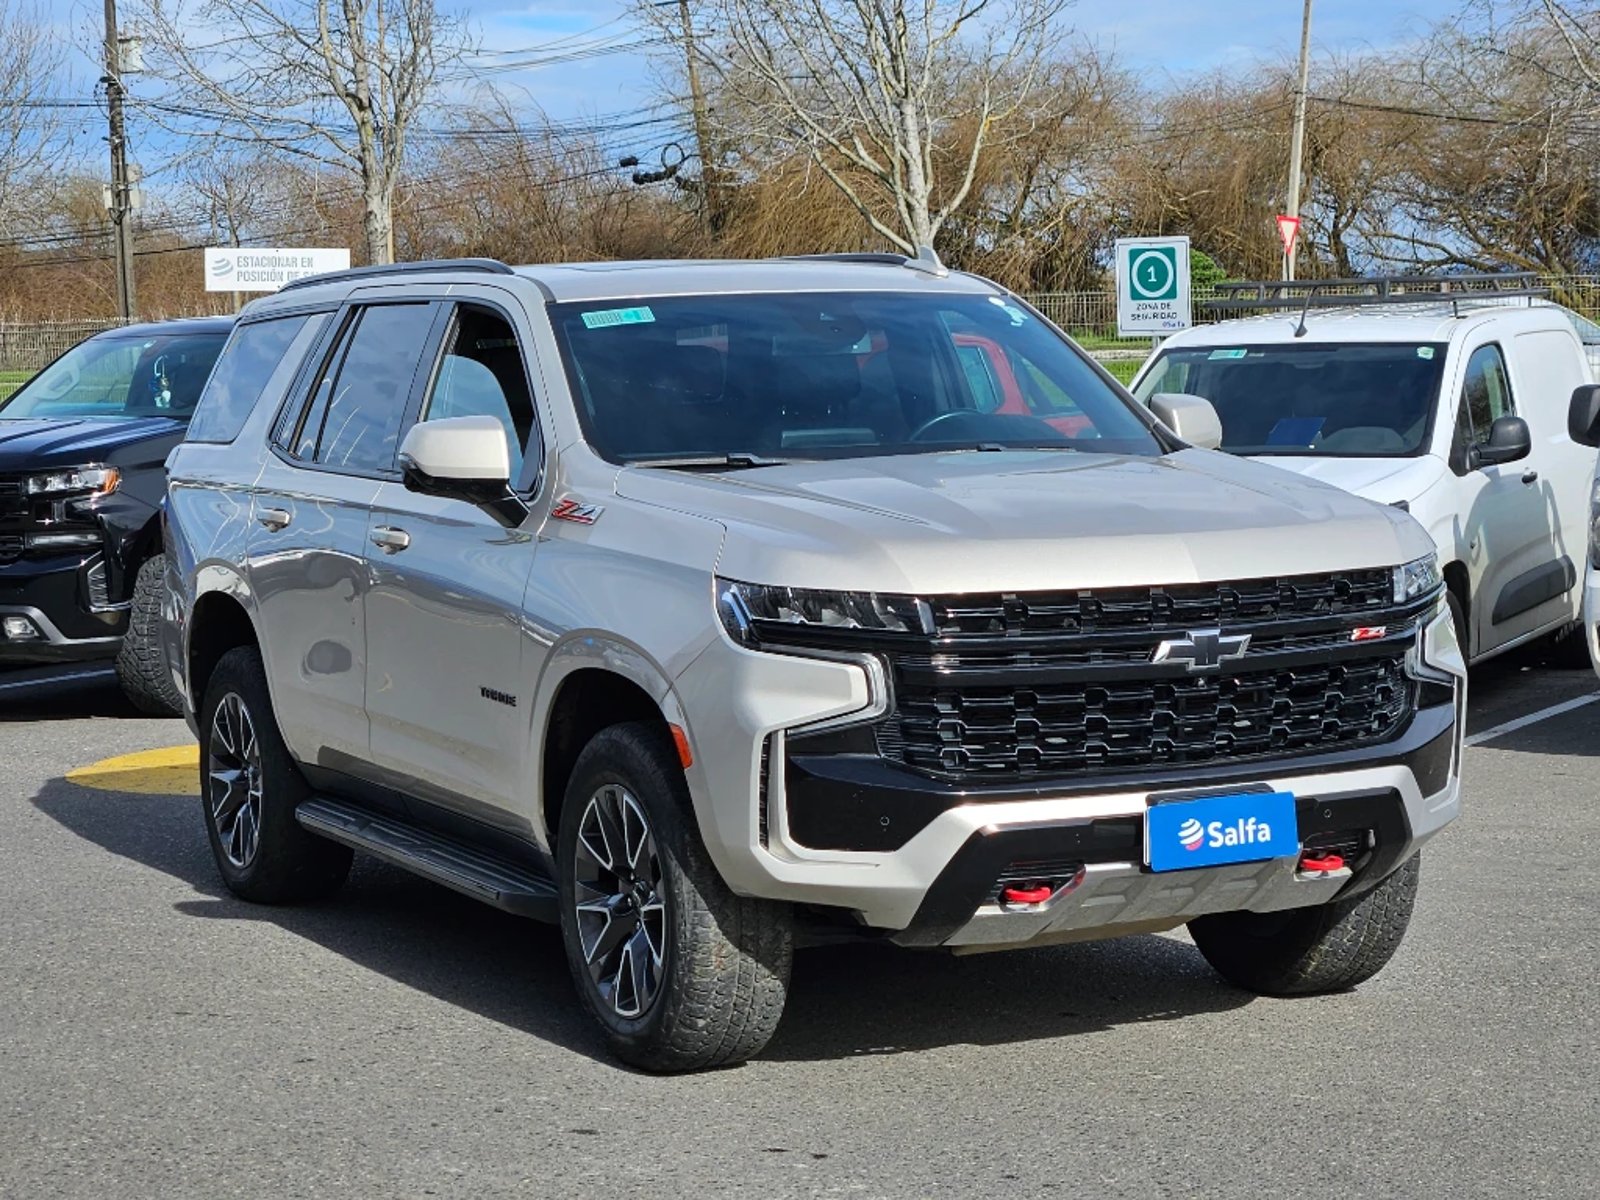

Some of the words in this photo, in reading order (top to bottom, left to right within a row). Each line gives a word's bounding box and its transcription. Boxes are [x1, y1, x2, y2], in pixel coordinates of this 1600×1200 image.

[237, 256, 298, 268] ESTACIONAR
[301, 256, 314, 268] EN
[237, 268, 284, 282] POSICIÓN
[1147, 265, 1157, 282] 1
[1160, 302, 1172, 311] DE
[1207, 816, 1271, 848] Salfa
